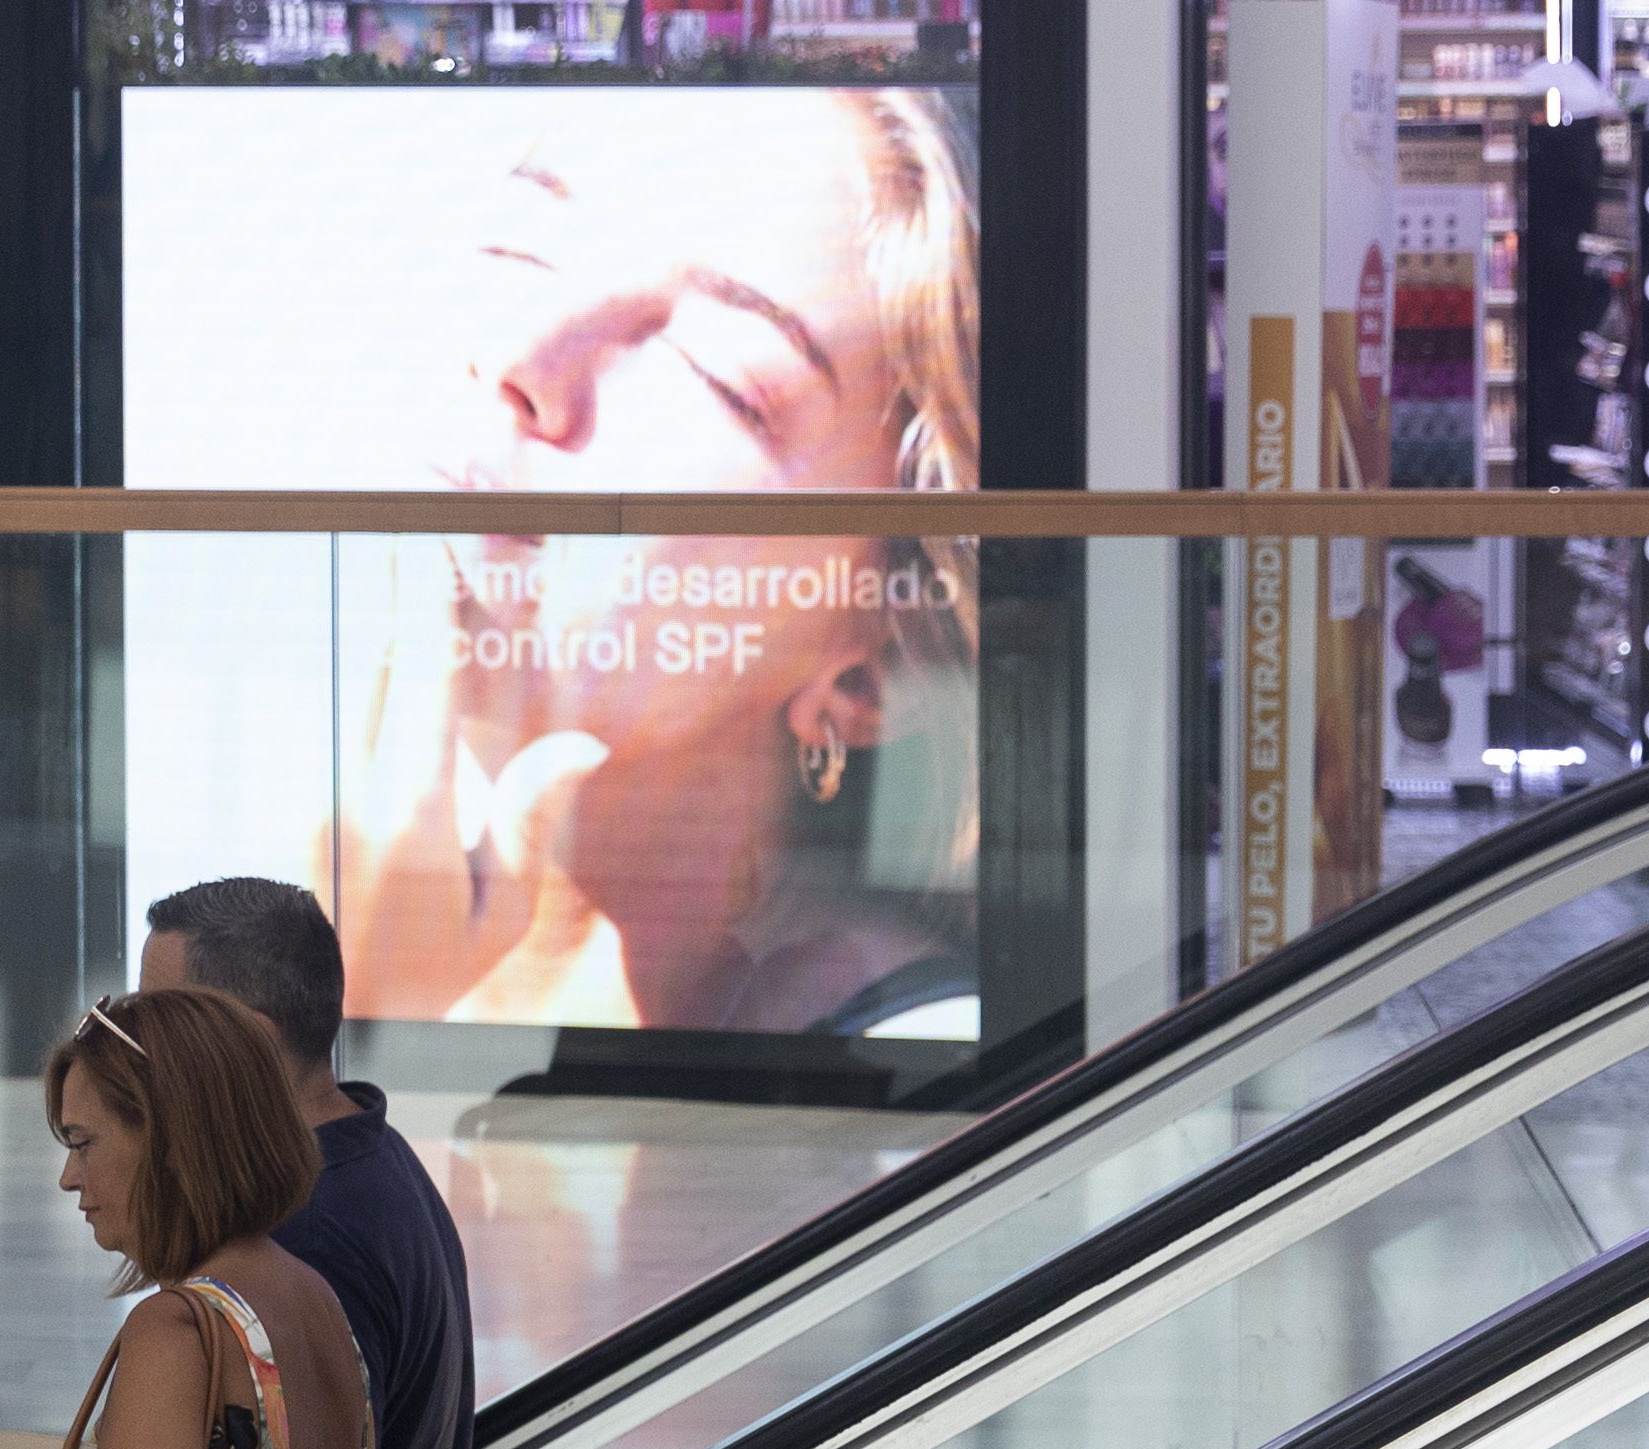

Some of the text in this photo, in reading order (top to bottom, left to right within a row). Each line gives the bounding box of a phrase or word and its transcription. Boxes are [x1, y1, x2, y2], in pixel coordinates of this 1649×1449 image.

[618, 554, 960, 610] desarrollado
[447, 620, 765, 676] control SPF
[1249, 400, 1286, 962] TU PELO, EXTRAORDIARIO
